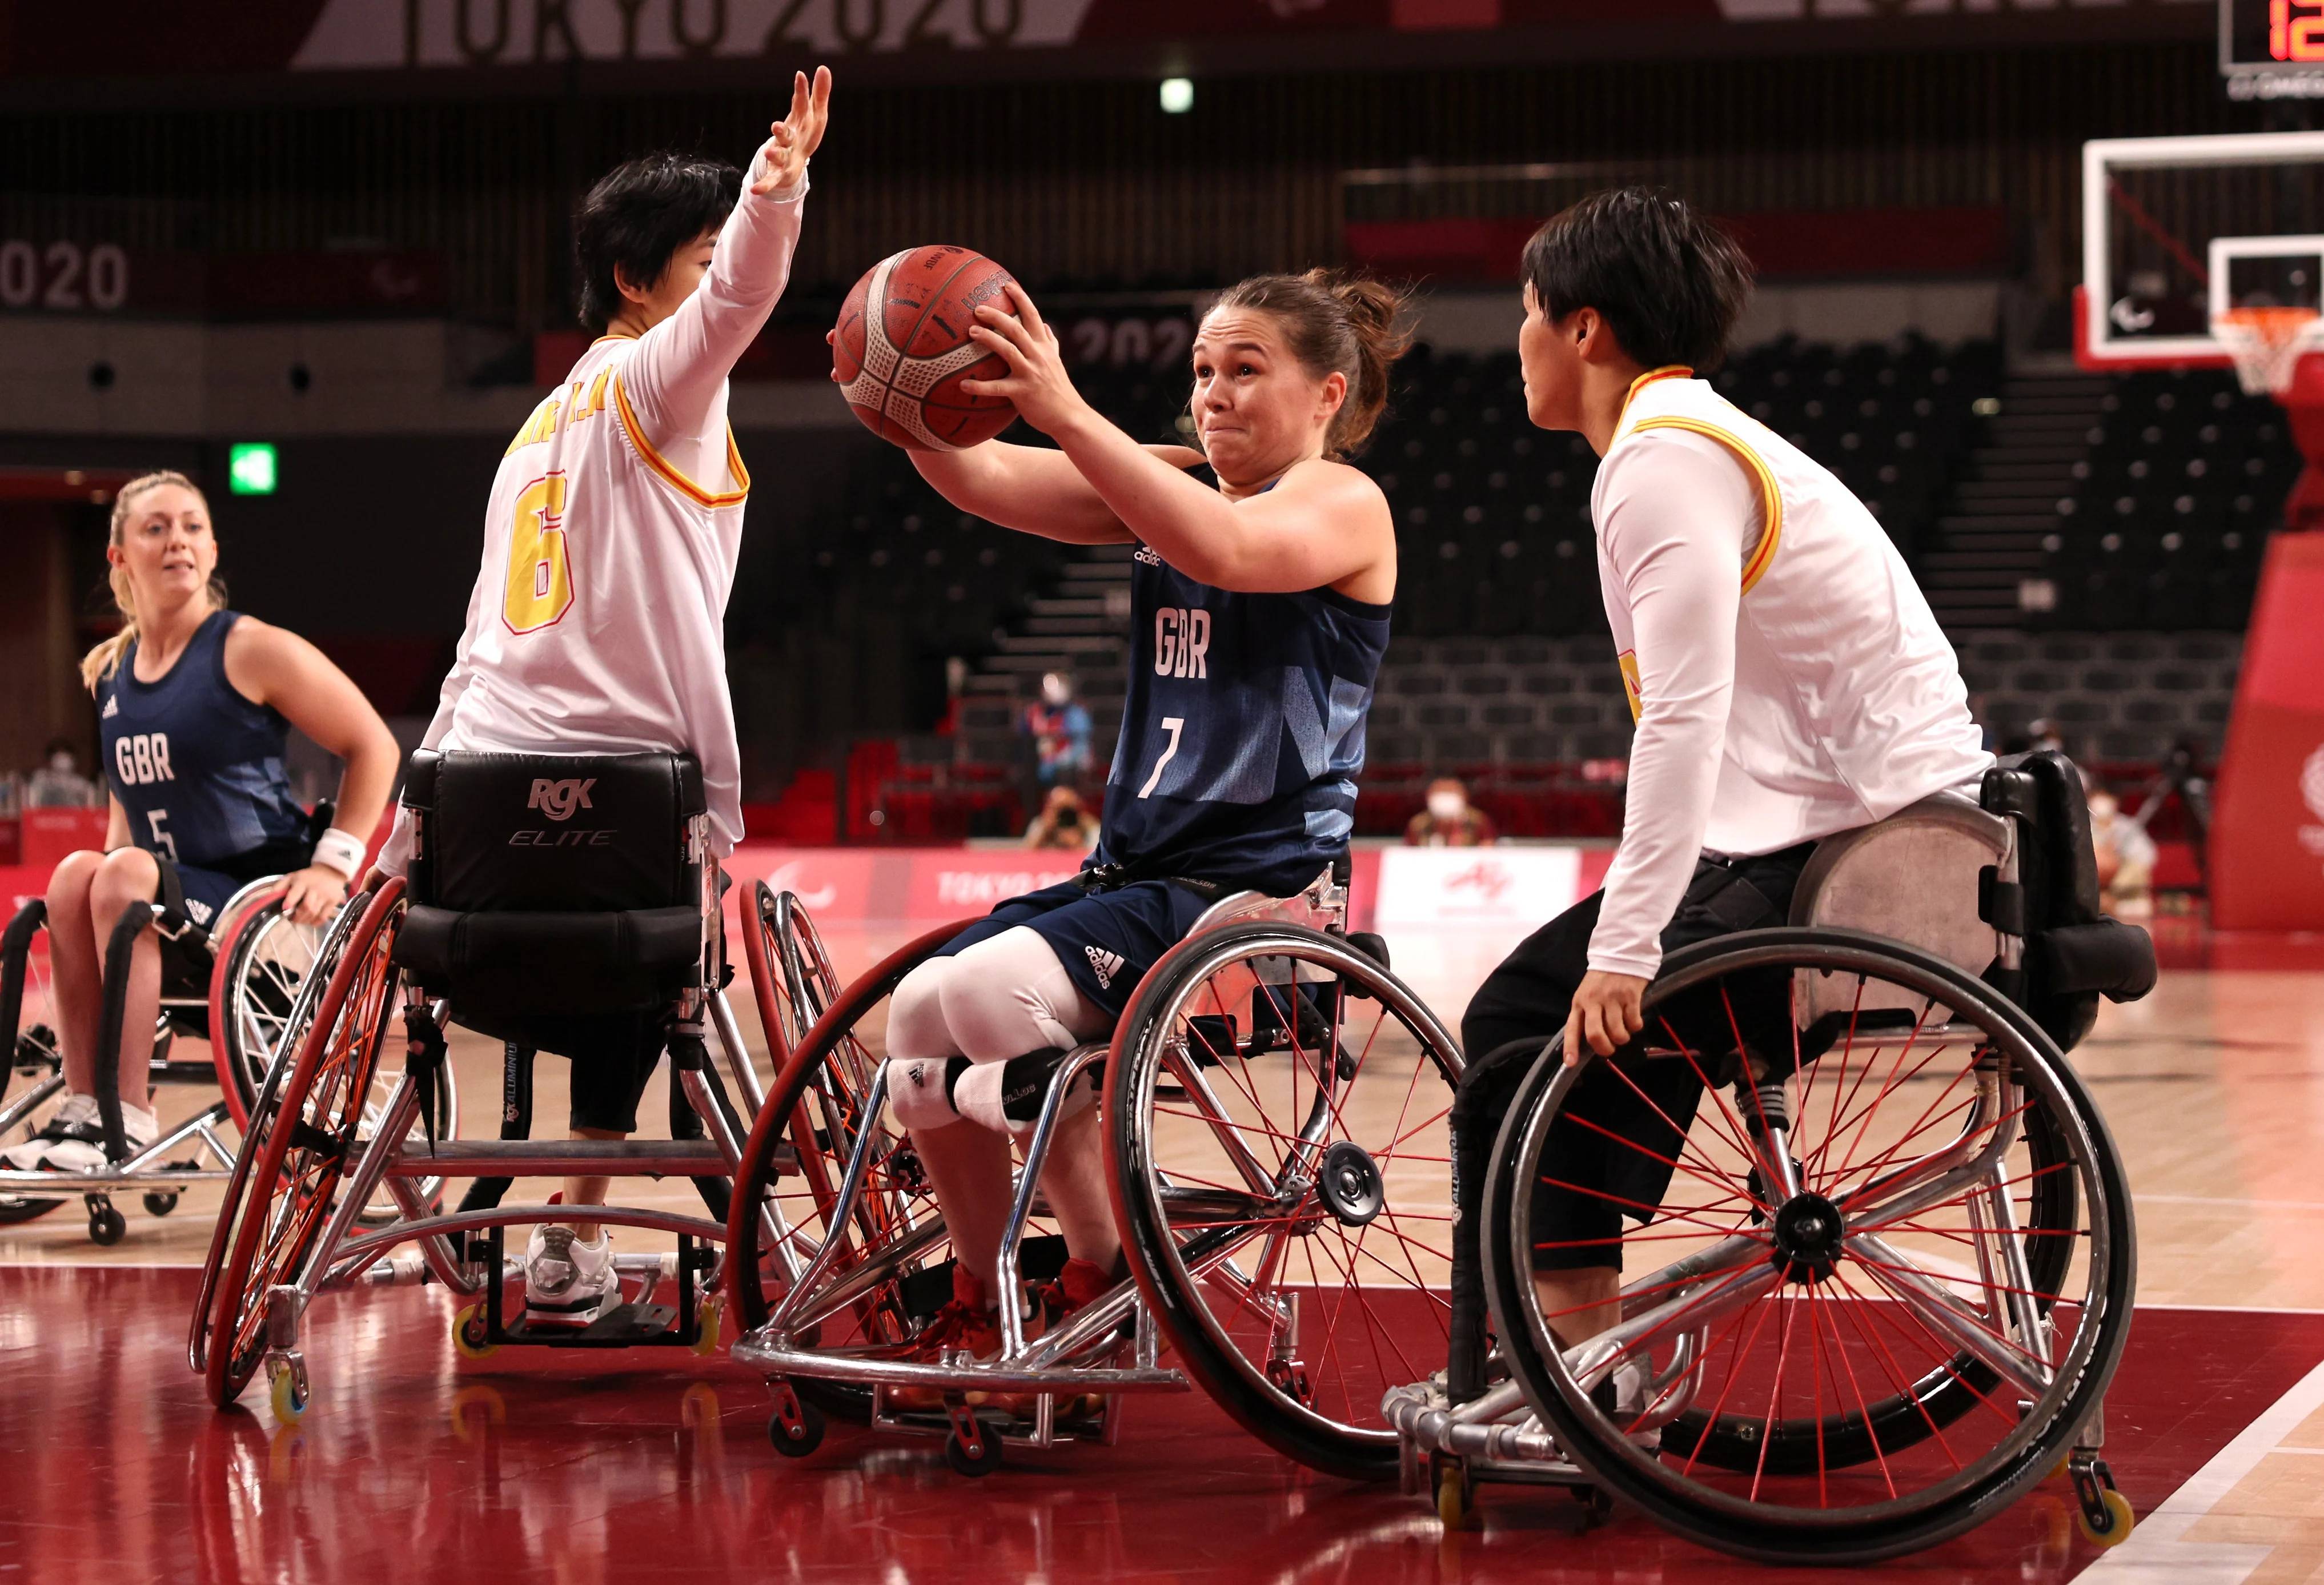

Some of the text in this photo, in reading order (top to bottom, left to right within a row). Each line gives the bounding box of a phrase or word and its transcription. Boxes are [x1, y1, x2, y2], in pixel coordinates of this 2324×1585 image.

[501, 469, 575, 636] 6
[1154, 606, 1211, 679] GBR
[115, 732, 176, 787] GBR
[1137, 717, 1185, 800] 7
[527, 777, 598, 821] RGK
[146, 808, 180, 864] 5
[508, 829, 617, 846] ELITE
[1085, 945, 1111, 990] adidas
